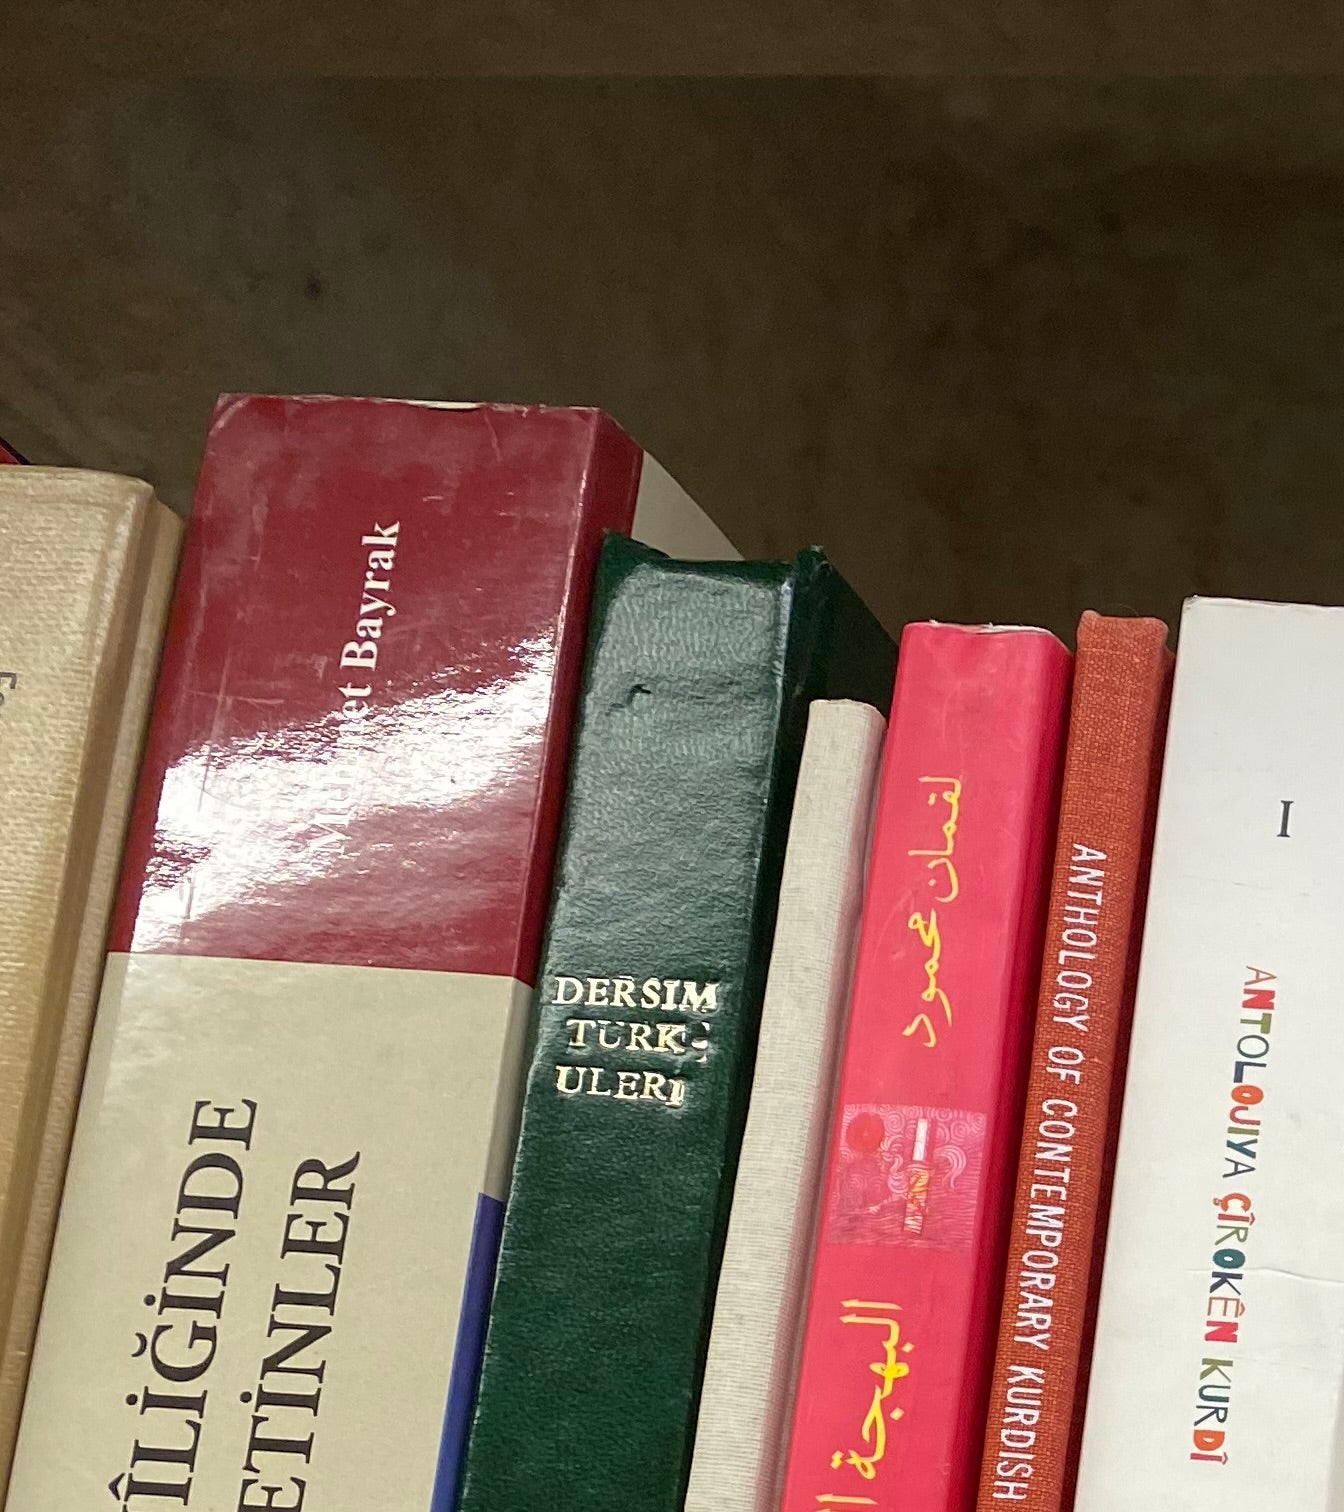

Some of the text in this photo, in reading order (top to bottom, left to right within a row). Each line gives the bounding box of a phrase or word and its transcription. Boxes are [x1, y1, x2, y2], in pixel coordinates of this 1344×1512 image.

[340, 521, 400, 671] Bayrak
[1276, 800, 1294, 838] I
[1047, 844, 1107, 1033] ANTHOLOGY
[1047, 1045, 1081, 1088] OF
[1009, 1098, 1078, 1353] CONTEMPORARY
[1190, 965, 1276, 1465] ANTOLOJIYA ÇÎROKÊN KURDÎ
[990, 1366, 1046, 1502] KURDISH
